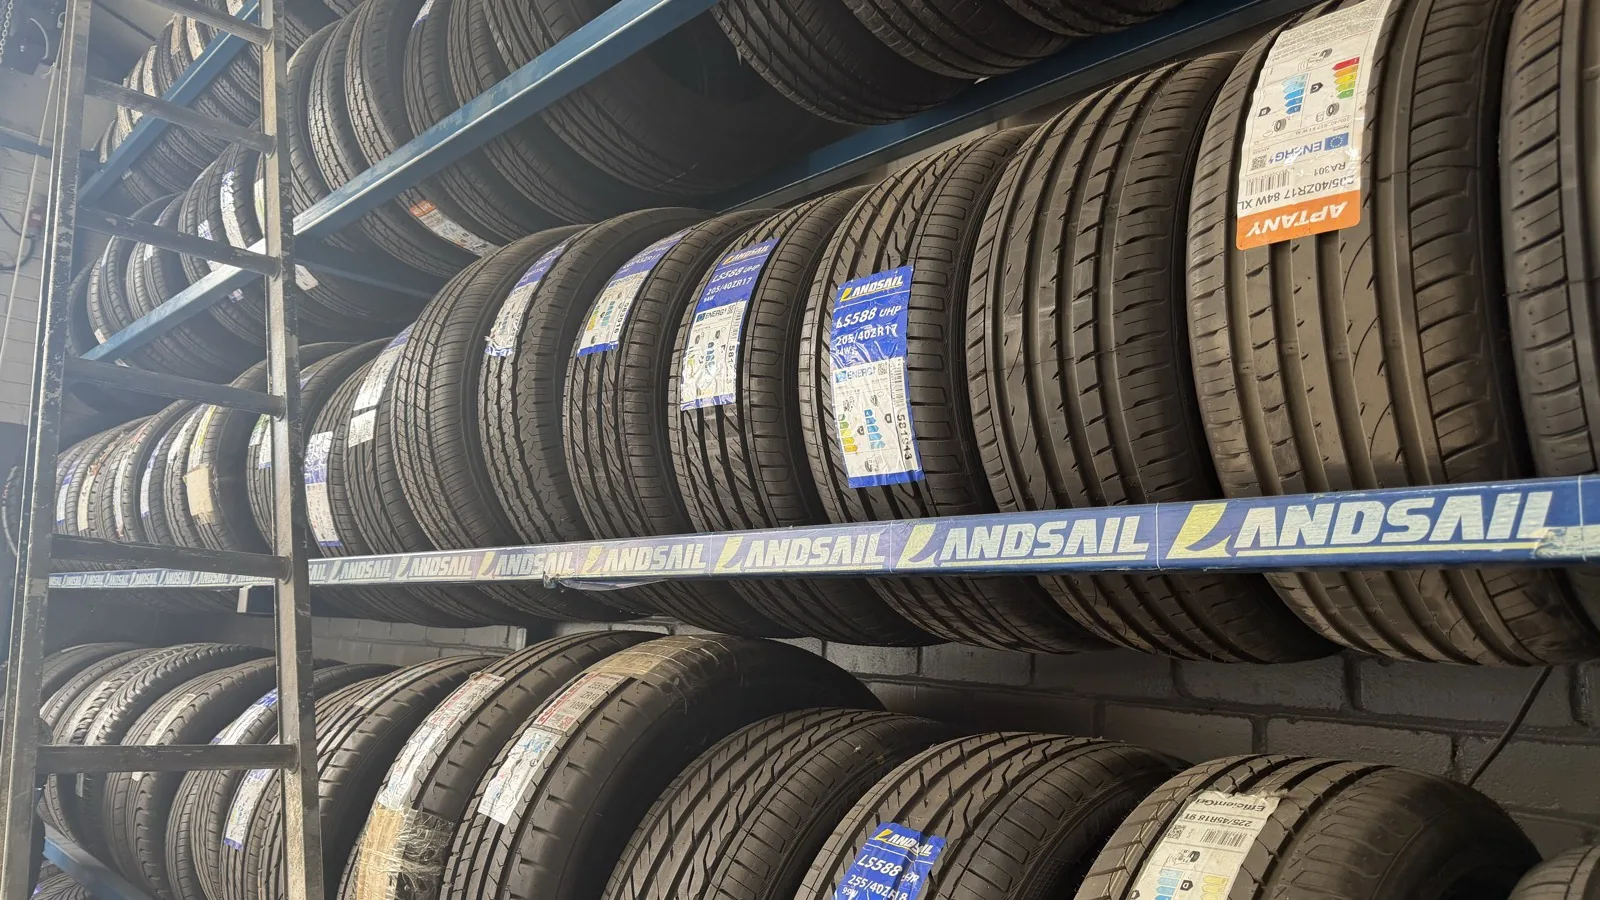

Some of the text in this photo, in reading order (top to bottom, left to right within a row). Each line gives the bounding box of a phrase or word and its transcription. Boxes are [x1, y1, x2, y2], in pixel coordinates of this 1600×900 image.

[1313, 161, 1346, 177] RA301
[1238, 198, 1253, 210] XL
[1256, 191, 1282, 208] 84W
[1246, 201, 1348, 238] APTANY
[706, 276, 753, 296] 205/40ZR17
[840, 275, 903, 302] LANDSAIL
[836, 305, 902, 329] LS588 UHP
[835, 323, 899, 347] 205/40ZR17
[1165, 491, 1553, 560] LANDSAIL
[713, 533, 885, 573] LANDSAIL
[895, 515, 1150, 570] LANDSAIL
[328, 559, 392, 583] LANDSAIL
[394, 555, 473, 581] LANDSAIL
[476, 551, 575, 580] LANDSAIL
[580, 542, 706, 576] LANDSAIL
[1197, 814, 1254, 827] 225/45R18
[857, 854, 903, 877] LS588
